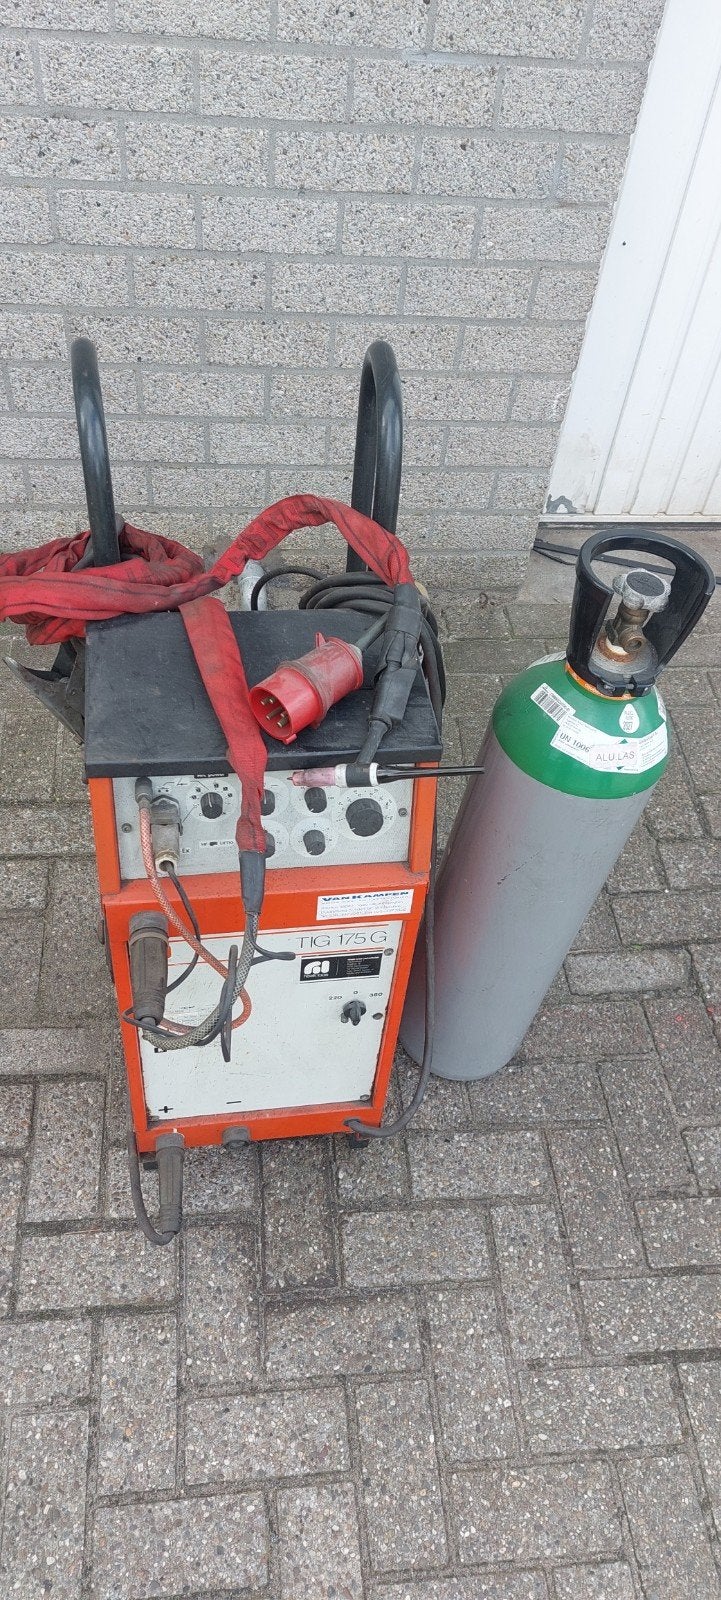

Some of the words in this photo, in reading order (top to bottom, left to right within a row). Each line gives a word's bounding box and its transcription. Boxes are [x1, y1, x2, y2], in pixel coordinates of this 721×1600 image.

[559, 732, 573, 743] UN
[572, 739, 591, 753] 1006
[296, 935, 331, 949] TIG
[338, 932, 367, 946] 175
[370, 930, 387, 944] G
